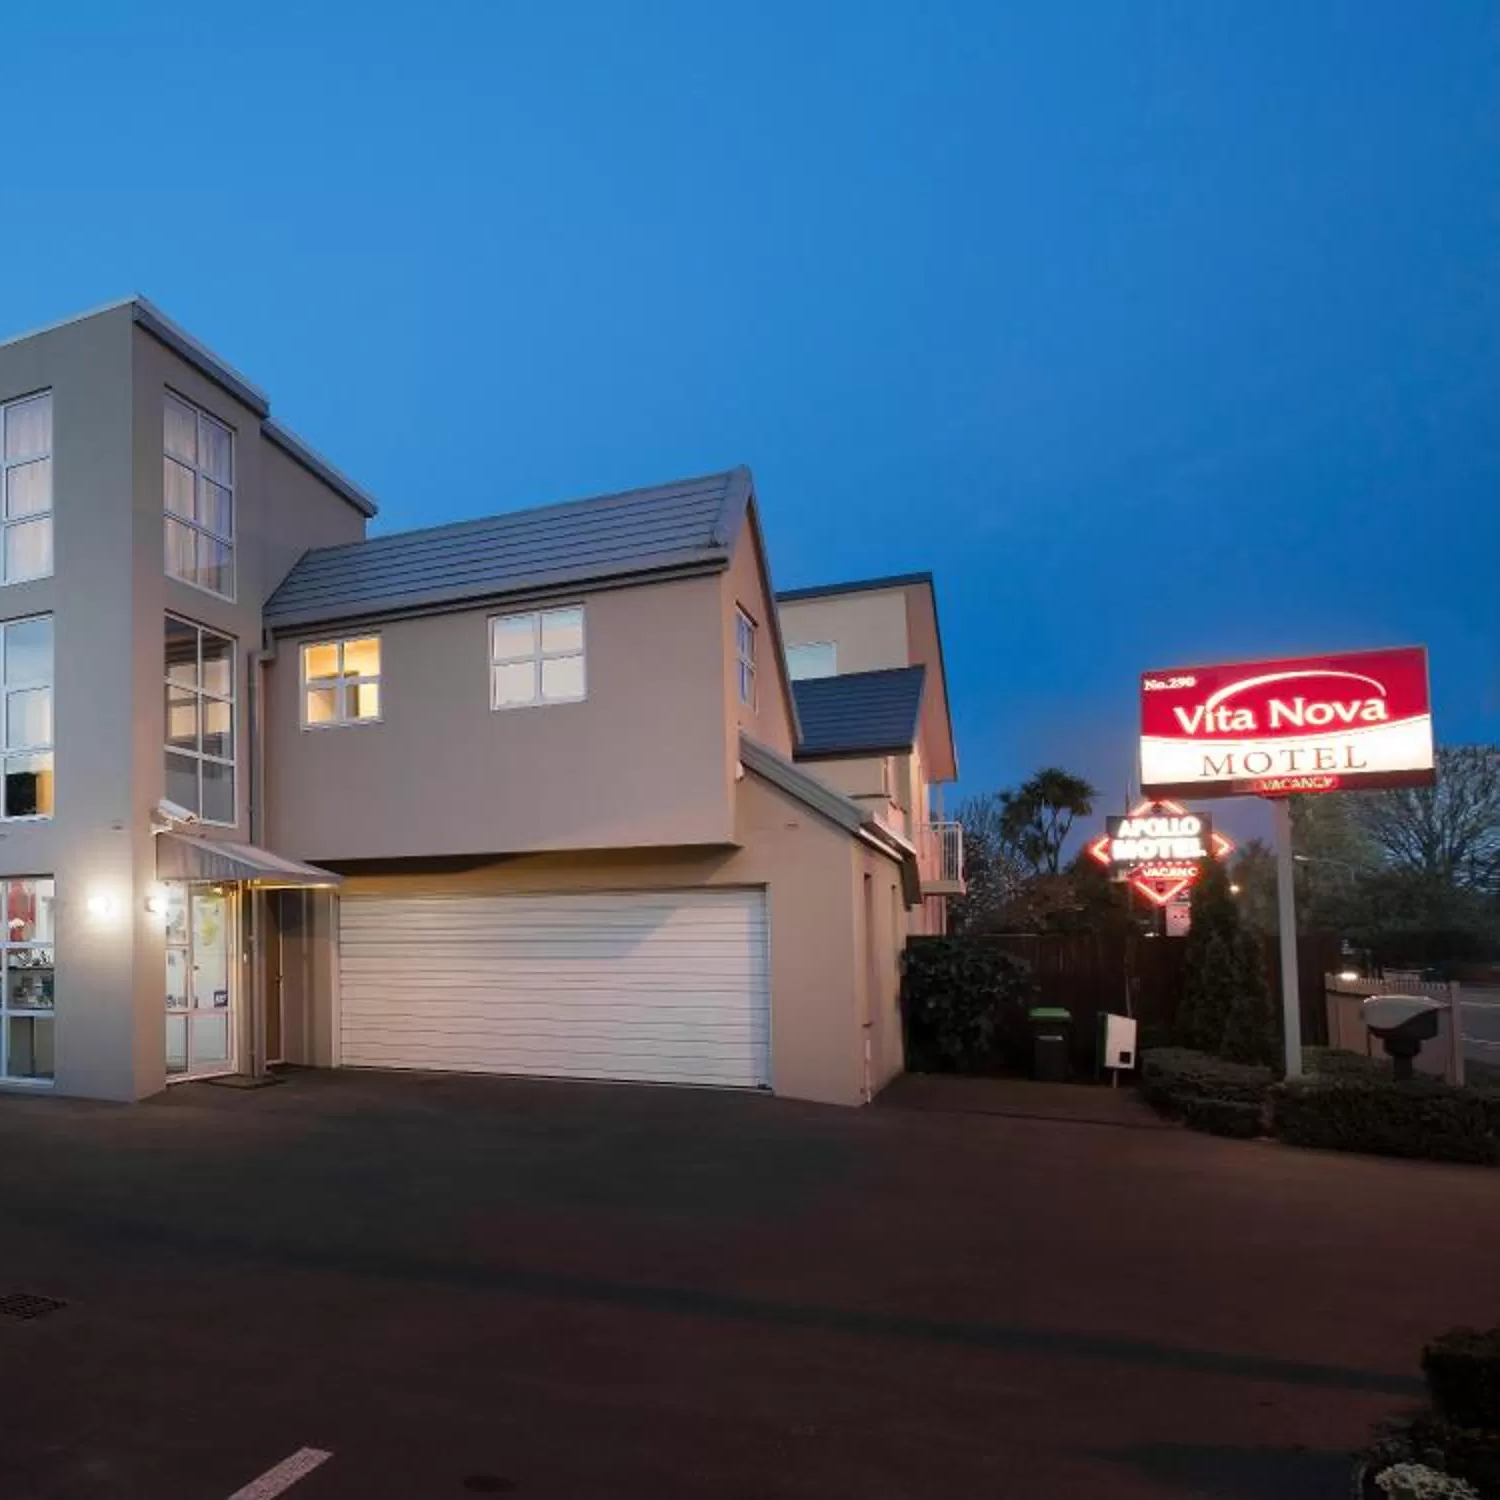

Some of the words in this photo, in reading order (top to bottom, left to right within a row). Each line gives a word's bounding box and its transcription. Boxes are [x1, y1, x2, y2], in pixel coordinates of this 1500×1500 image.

[1173, 704, 1257, 735] Vita
[1267, 697, 1389, 728] Nova
[1199, 745, 1367, 777] MOTEL
[1261, 775, 1333, 790] VACANCY
[1117, 815, 1201, 838] APOLLO
[1112, 837, 1207, 860] MOTEL
